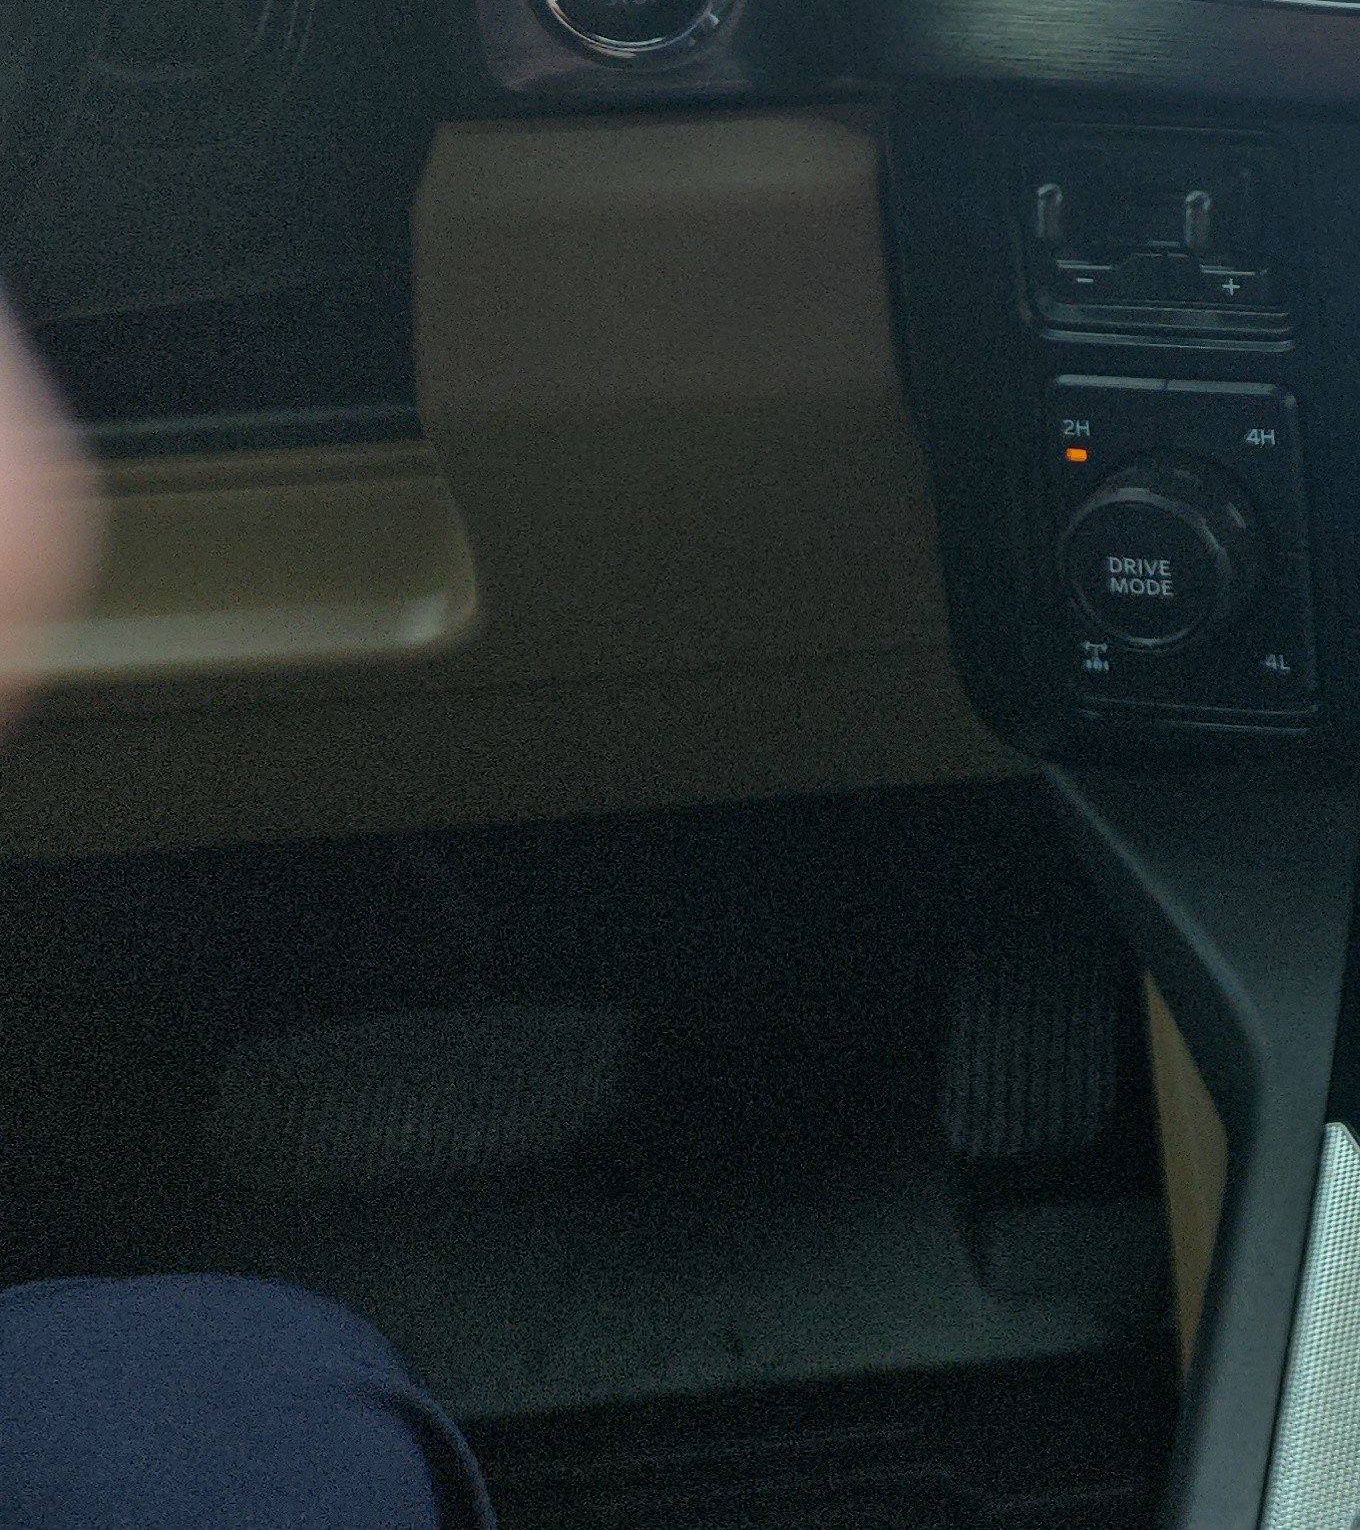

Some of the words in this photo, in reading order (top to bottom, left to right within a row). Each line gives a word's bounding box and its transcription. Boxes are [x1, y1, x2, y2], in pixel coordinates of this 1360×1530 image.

[1062, 419, 1090, 439] 2H
[1245, 428, 1276, 446] 4H
[1108, 556, 1171, 575] DRIVE
[1110, 577, 1174, 597] MODE
[1263, 653, 1291, 672] 4L
